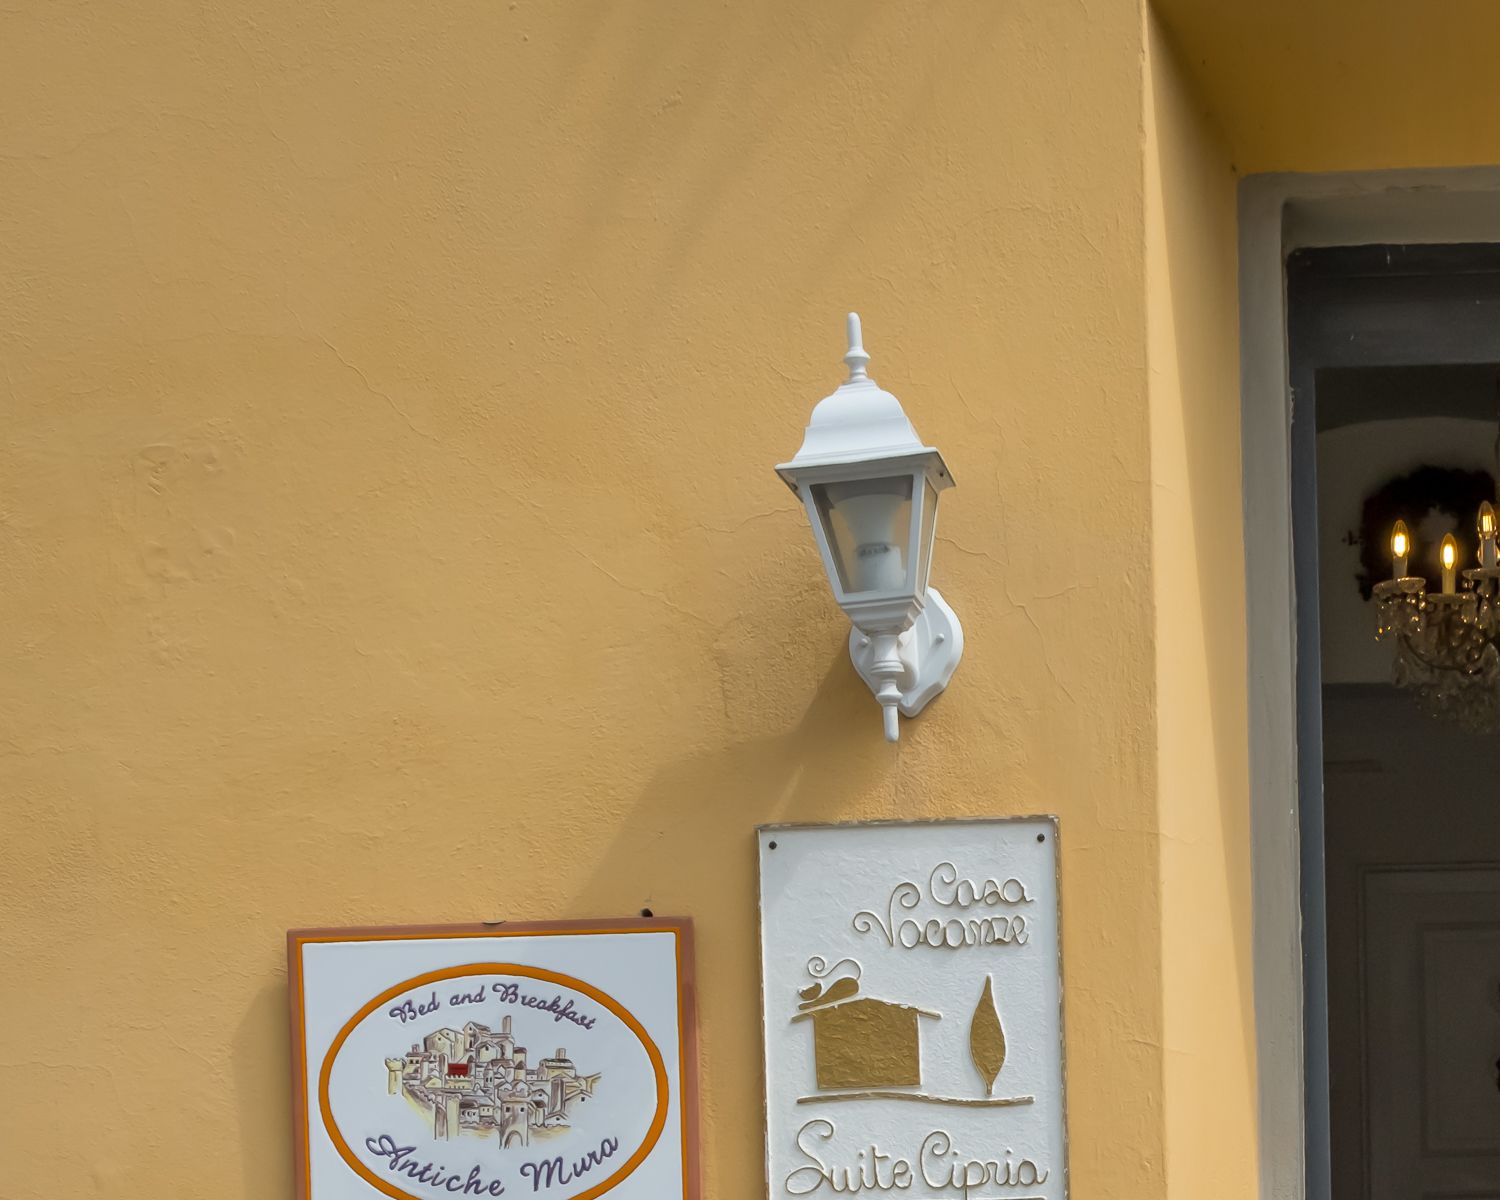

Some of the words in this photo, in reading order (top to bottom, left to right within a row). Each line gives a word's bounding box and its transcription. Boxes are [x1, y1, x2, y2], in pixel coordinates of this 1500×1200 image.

[930, 861, 1033, 906] Casa
[852, 882, 1029, 949] Vacanze
[389, 992, 440, 1023] Bed
[449, 985, 486, 1007] and
[492, 983, 596, 1031] Breakfast
[365, 1134, 505, 1197] Antiche
[520, 1136, 619, 1192] Mura
[785, 1119, 914, 1195] Suite
